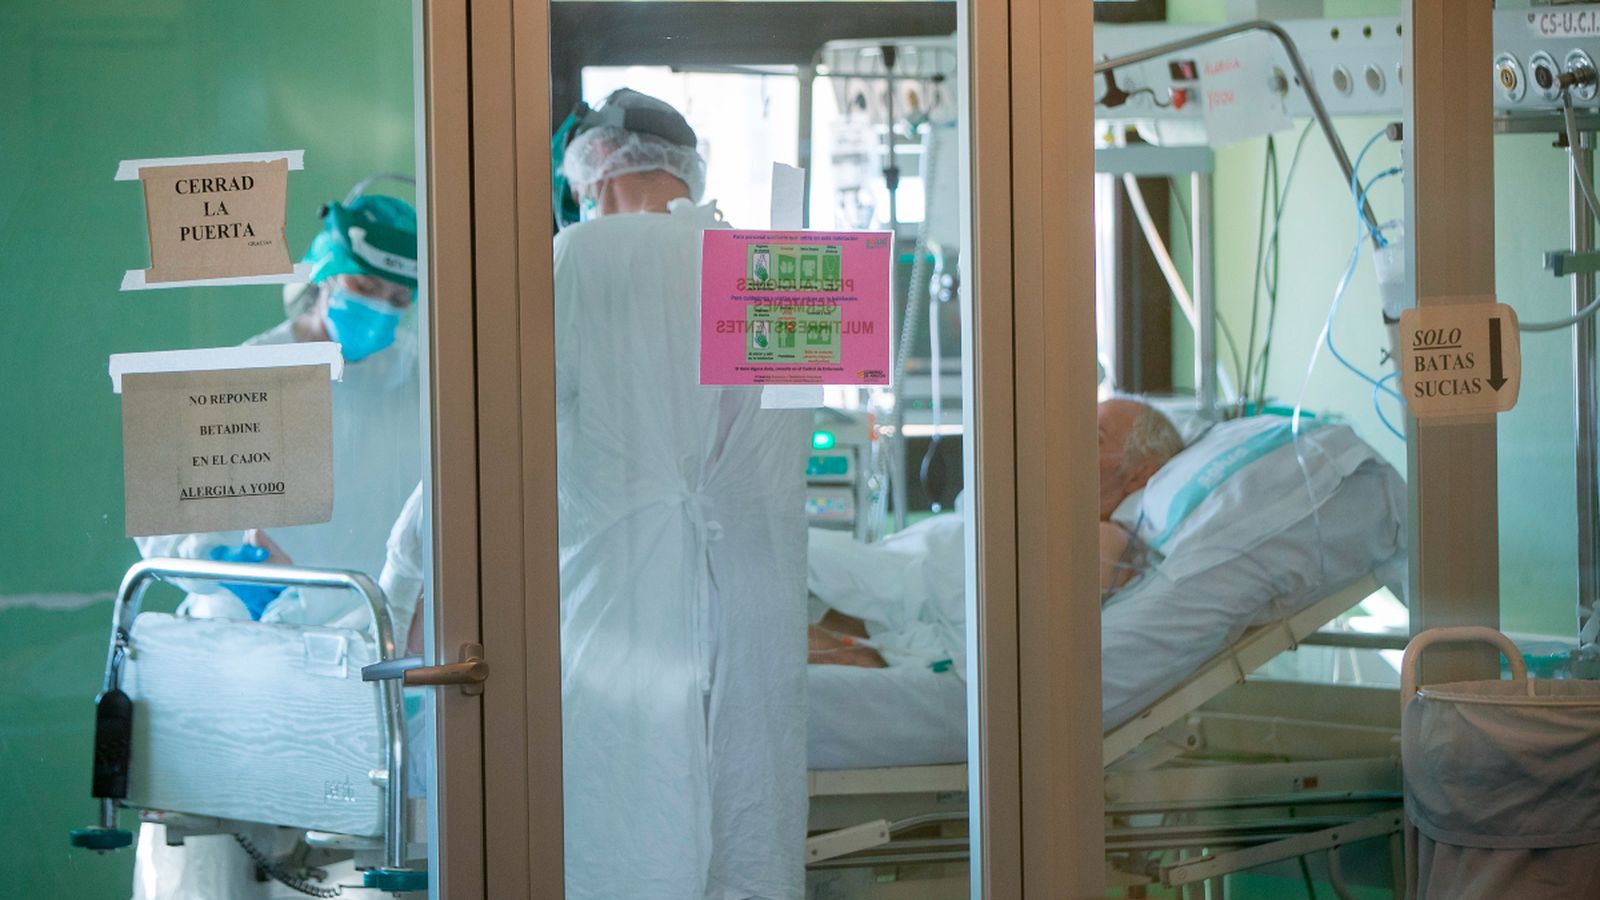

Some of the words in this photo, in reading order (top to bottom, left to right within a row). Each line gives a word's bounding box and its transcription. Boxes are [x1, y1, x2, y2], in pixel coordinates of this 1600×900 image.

[175, 175, 254, 195] CERRAD
[203, 200, 229, 217] LA
[179, 222, 256, 242] PUERTA
[1413, 328, 1462, 347] SOLO
[1415, 352, 1475, 372] BATAS
[1415, 378, 1482, 398] SUCIAS
[189, 395, 208, 406] NO
[210, 392, 268, 405] REPONER
[200, 422, 261, 436] BETADINE
[192, 456, 209, 467] EN
[212, 455, 228, 466] EL
[230, 452, 271, 464] CAJON
[180, 485, 236, 499] ALERGIA
[238, 485, 247, 495] A
[250, 481, 285, 494] YODO
